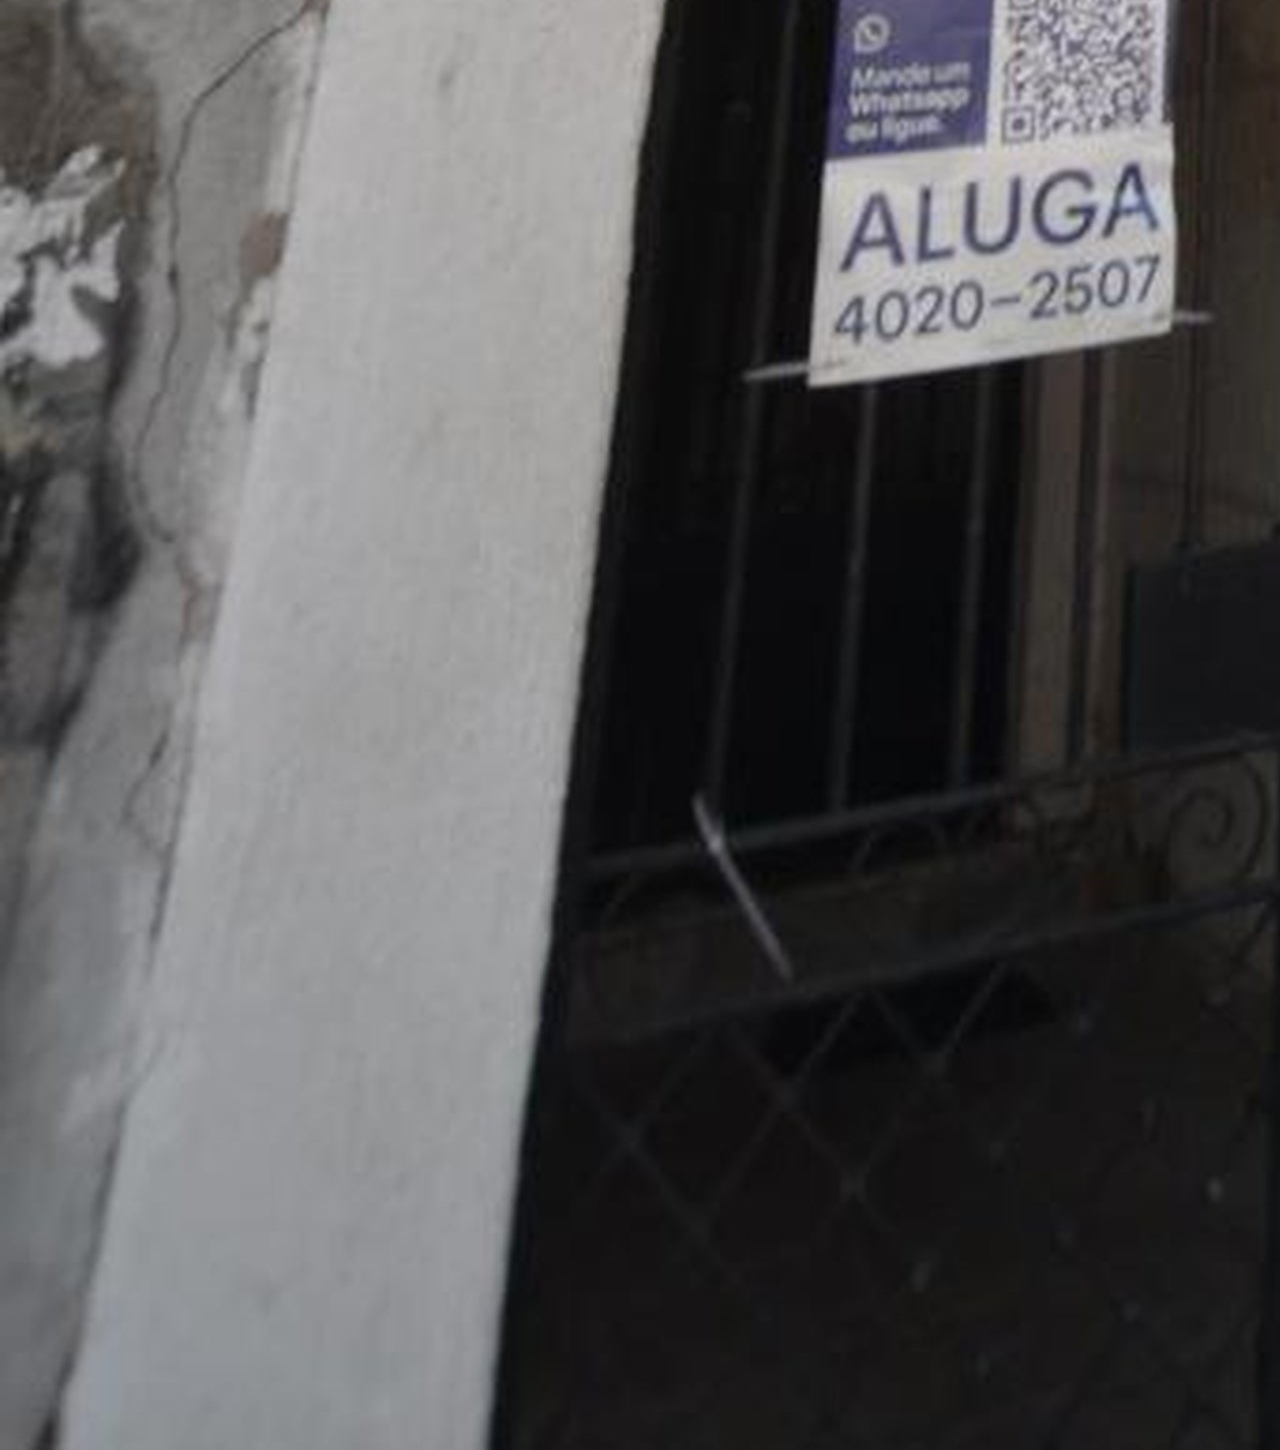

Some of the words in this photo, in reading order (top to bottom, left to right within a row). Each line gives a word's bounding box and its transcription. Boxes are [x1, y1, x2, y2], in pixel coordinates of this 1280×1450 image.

[849, 63, 931, 90] Mande
[845, 121, 878, 143] ou
[839, 161, 1159, 274] ALUGA
[834, 255, 1162, 345] 4020-2507
